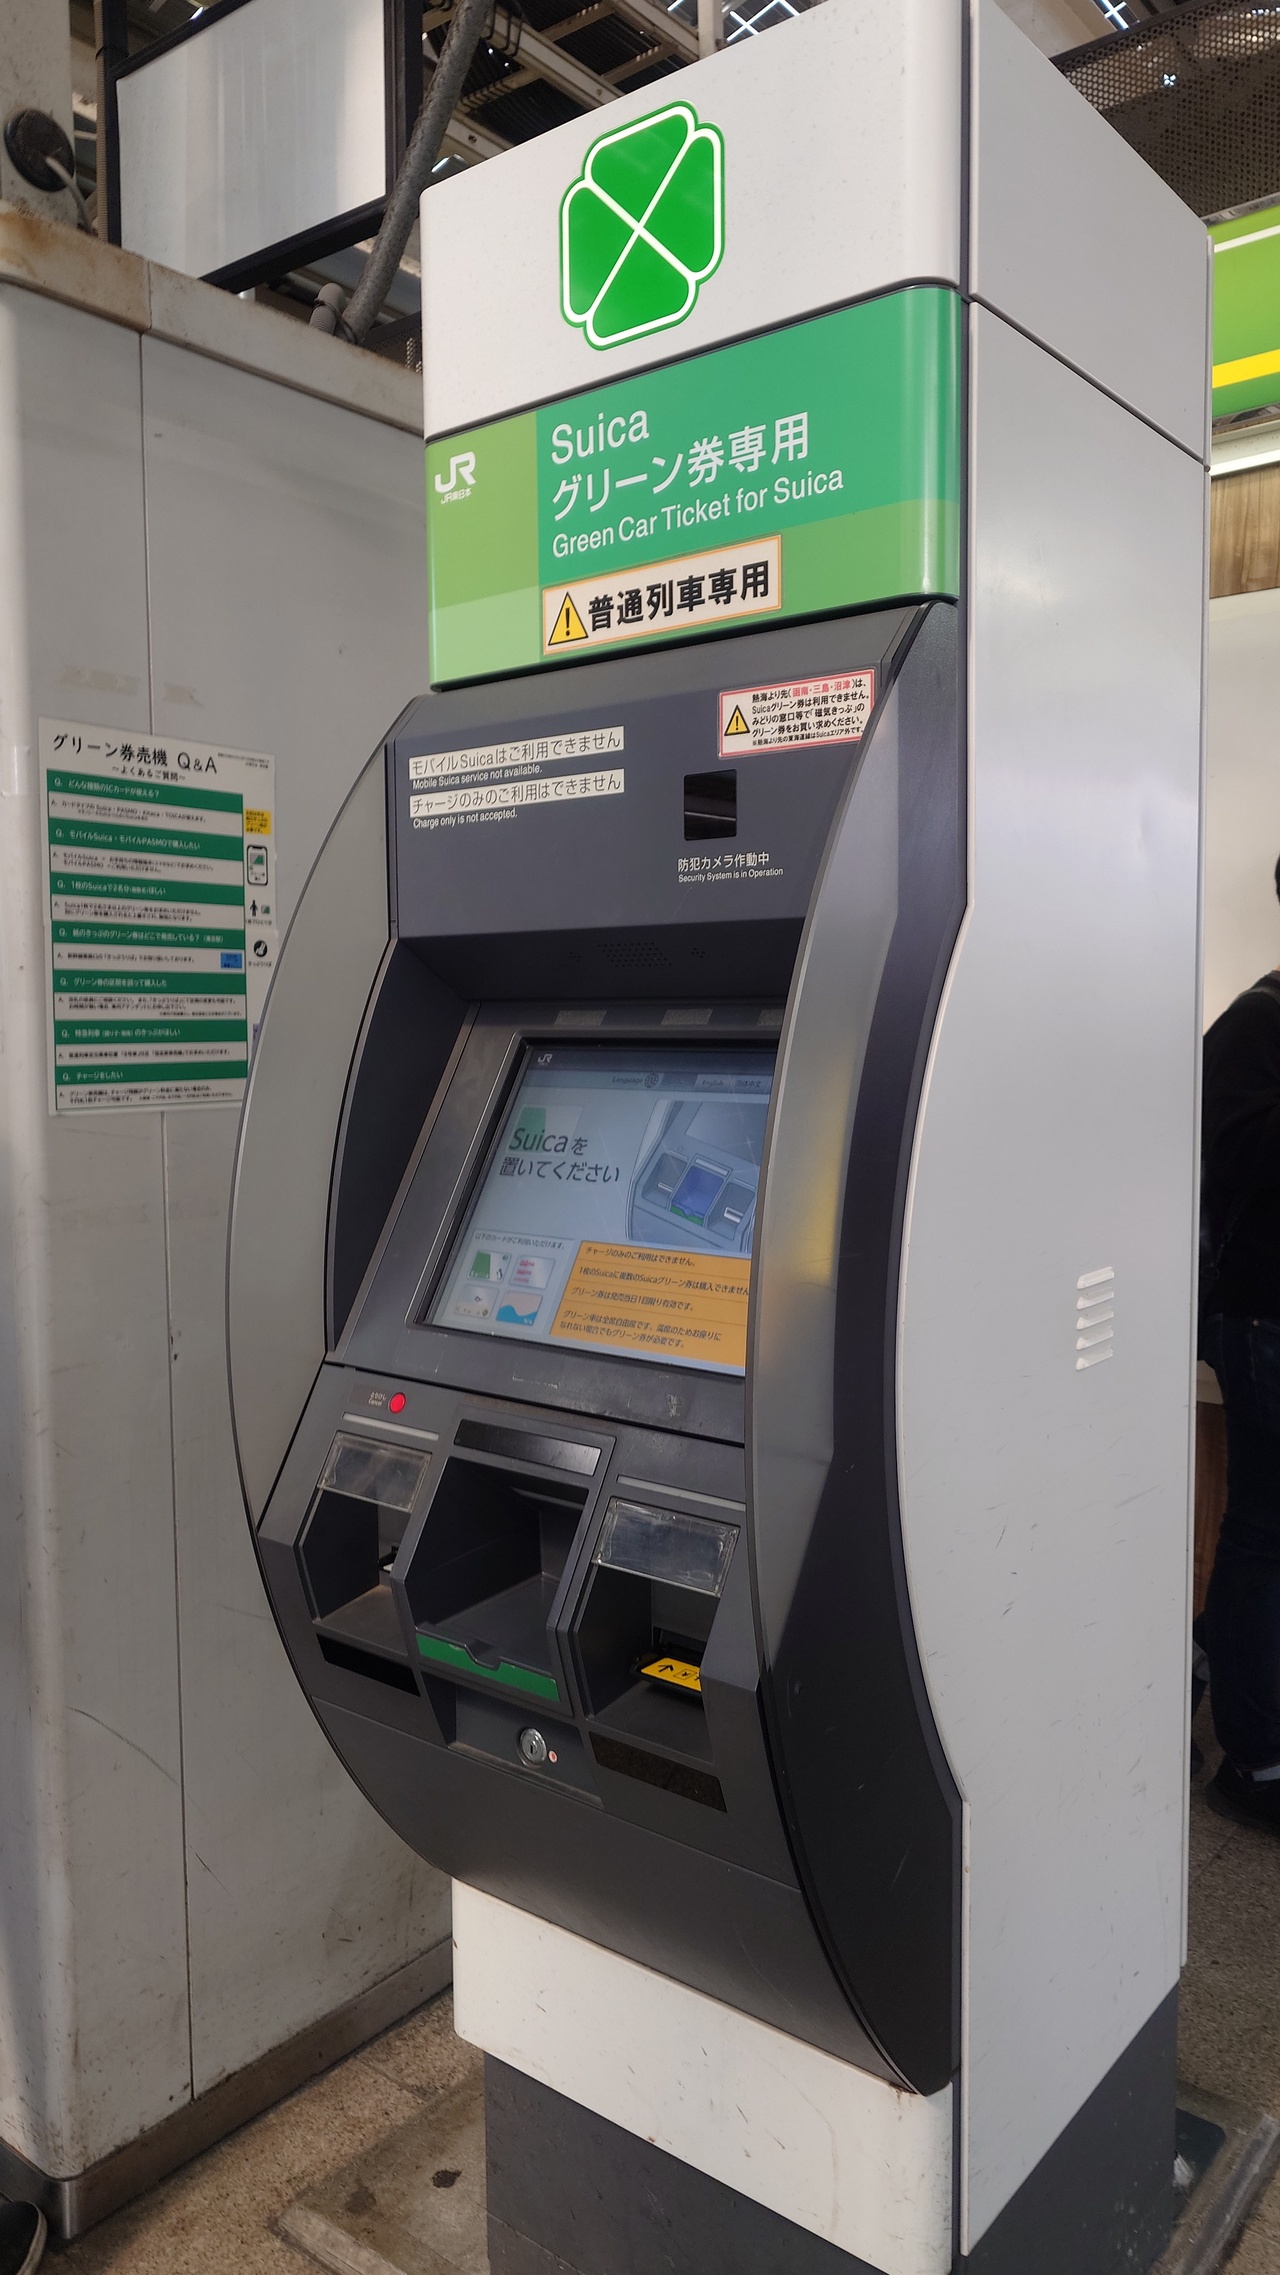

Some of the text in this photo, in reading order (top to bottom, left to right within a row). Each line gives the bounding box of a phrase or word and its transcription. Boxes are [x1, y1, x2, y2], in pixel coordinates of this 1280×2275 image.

[551, 409, 649, 464] Suica
[434, 451, 477, 493] JR
[552, 412, 810, 522] グリーン券専用
[552, 467, 844, 559] Green Car Ticket for Suica
[588, 560, 770, 632] 普通列車専用
[752, 690, 869, 714] Suicaグリーン券は利用できません。
[752, 716, 863, 738] グリーン券をお買い求めください。
[53, 733, 168, 767] グリーン券売機
[177, 751, 218, 774] Q&A
[413, 731, 621, 775] モバイルSuicaはご利用できません
[413, 764, 543, 790] Mobile Suica service not available.
[413, 774, 621, 814] チャージのみのご利用はできません
[413, 807, 518, 830] Charge only is not accepted.
[678, 851, 770, 872] 防犯カメラ作動中
[679, 867, 784, 883] Security System is in Operation
[508, 1127, 588, 1156] Suicaを
[498, 1156, 621, 1183] 置いてください
[586, 1246, 696, 1267] チャージのみのご利用はできません。
